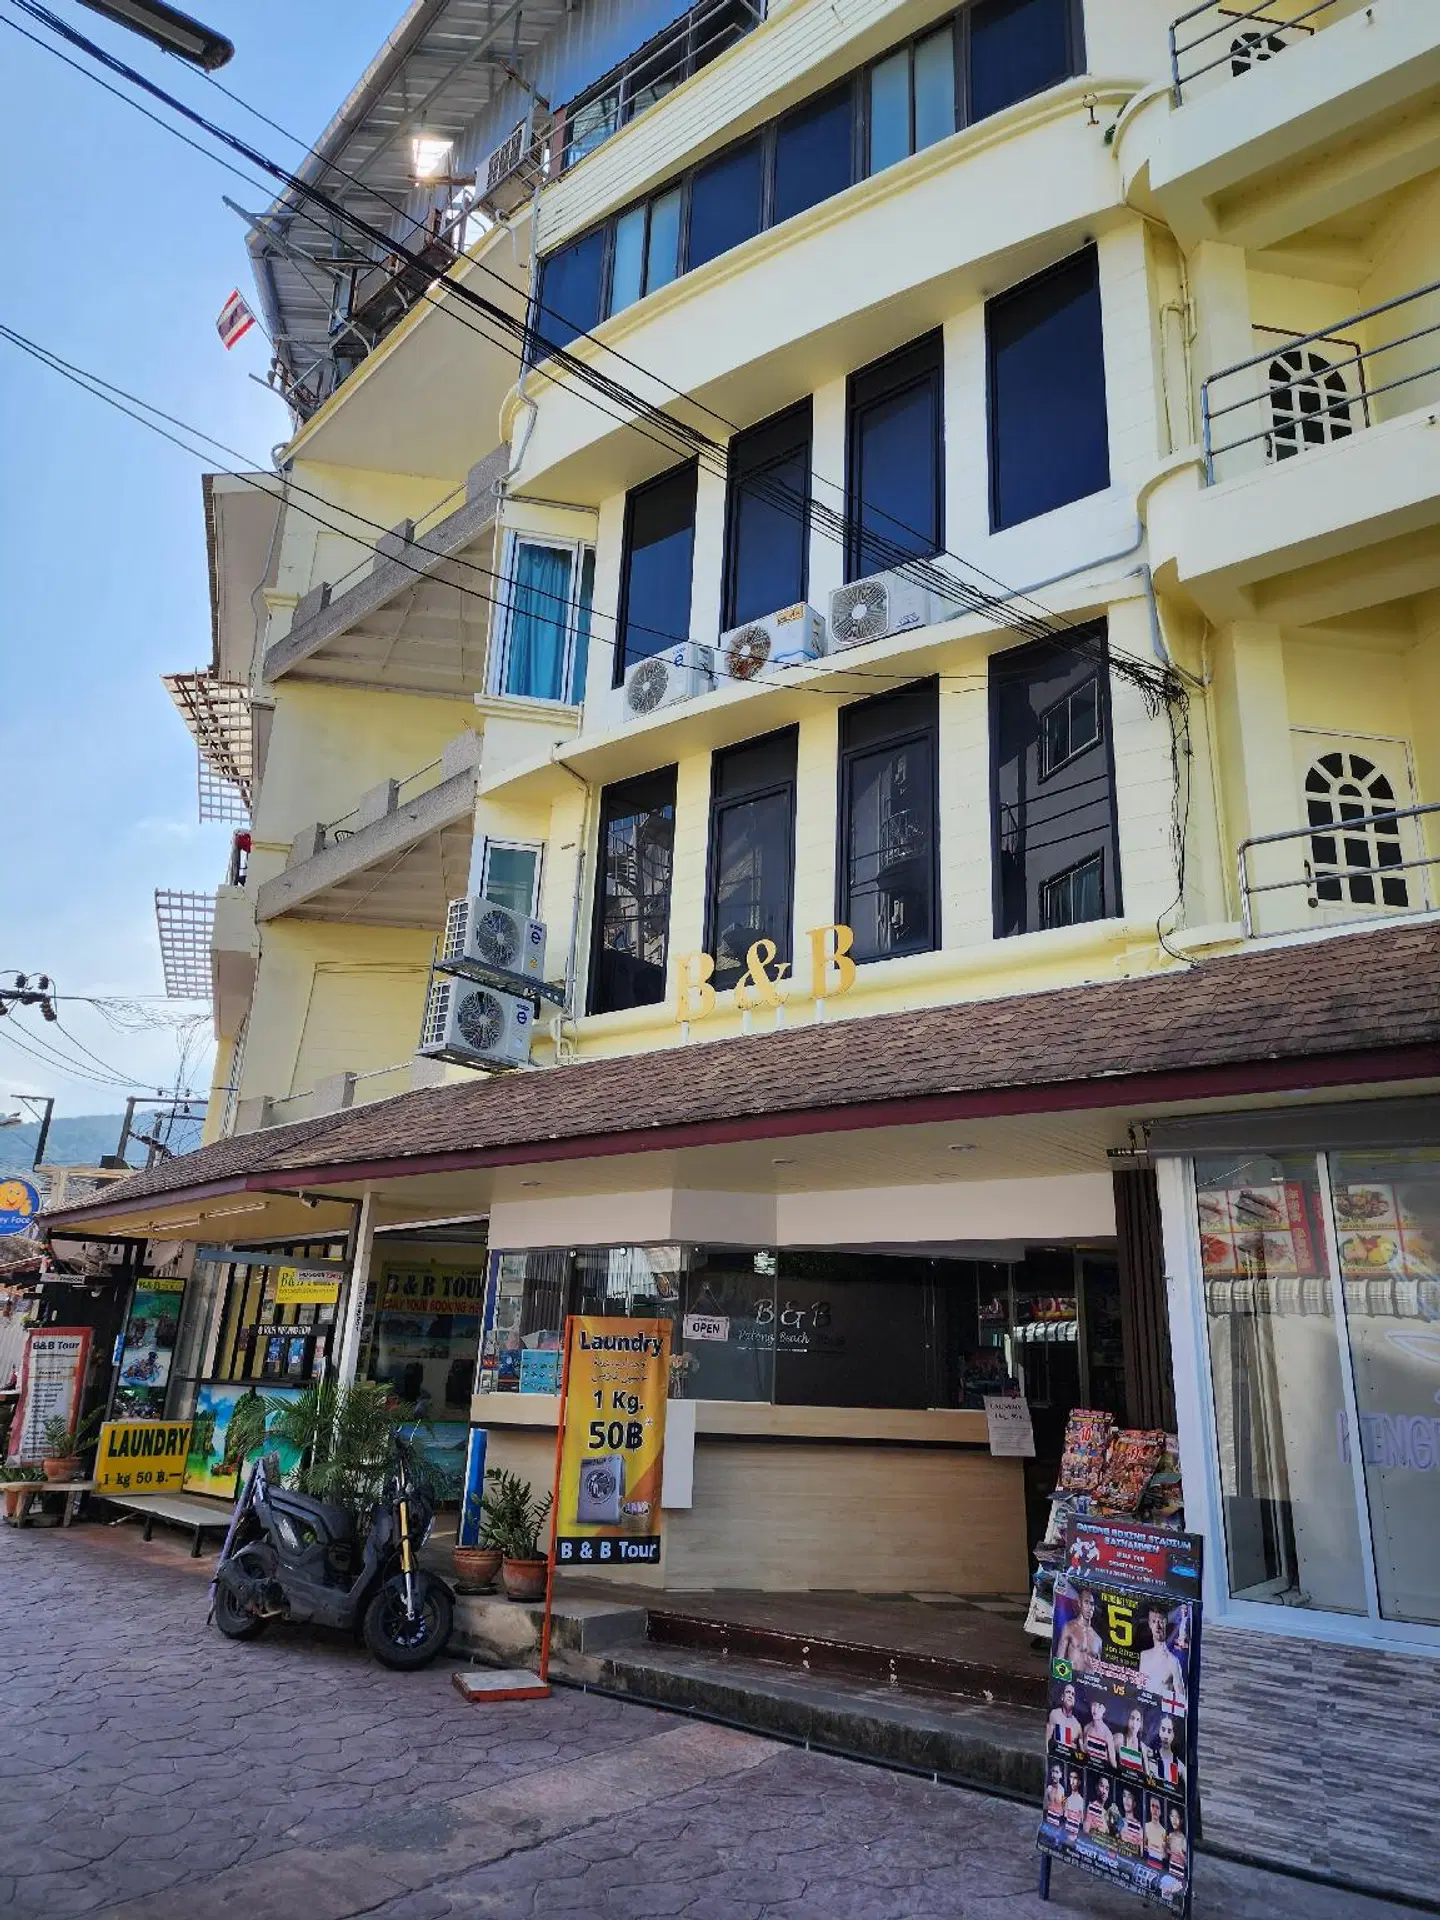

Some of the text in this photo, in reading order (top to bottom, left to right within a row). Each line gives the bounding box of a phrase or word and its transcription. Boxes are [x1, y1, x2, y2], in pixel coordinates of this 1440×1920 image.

[673, 923, 857, 1024] B & B
[752, 1299, 775, 1325] B
[692, 1322, 720, 1334] OPEN
[32, 1341, 80, 1350] B&B Tour
[580, 1331, 663, 1358] Laundry
[779, 1331, 811, 1344] Beach
[593, 1389, 645, 1415] 1 Kg.
[107, 1427, 190, 1458] LAUNDRY
[104, 1473, 109, 1485] 1
[116, 1472, 132, 1488] kg
[136, 1471, 153, 1484] 50
[561, 1541, 657, 1559] B & B Tour
[1149, 1534, 1192, 1551] STADIUM
[1107, 1604, 1133, 1647] 5
[1112, 1683, 1127, 1696] VS
